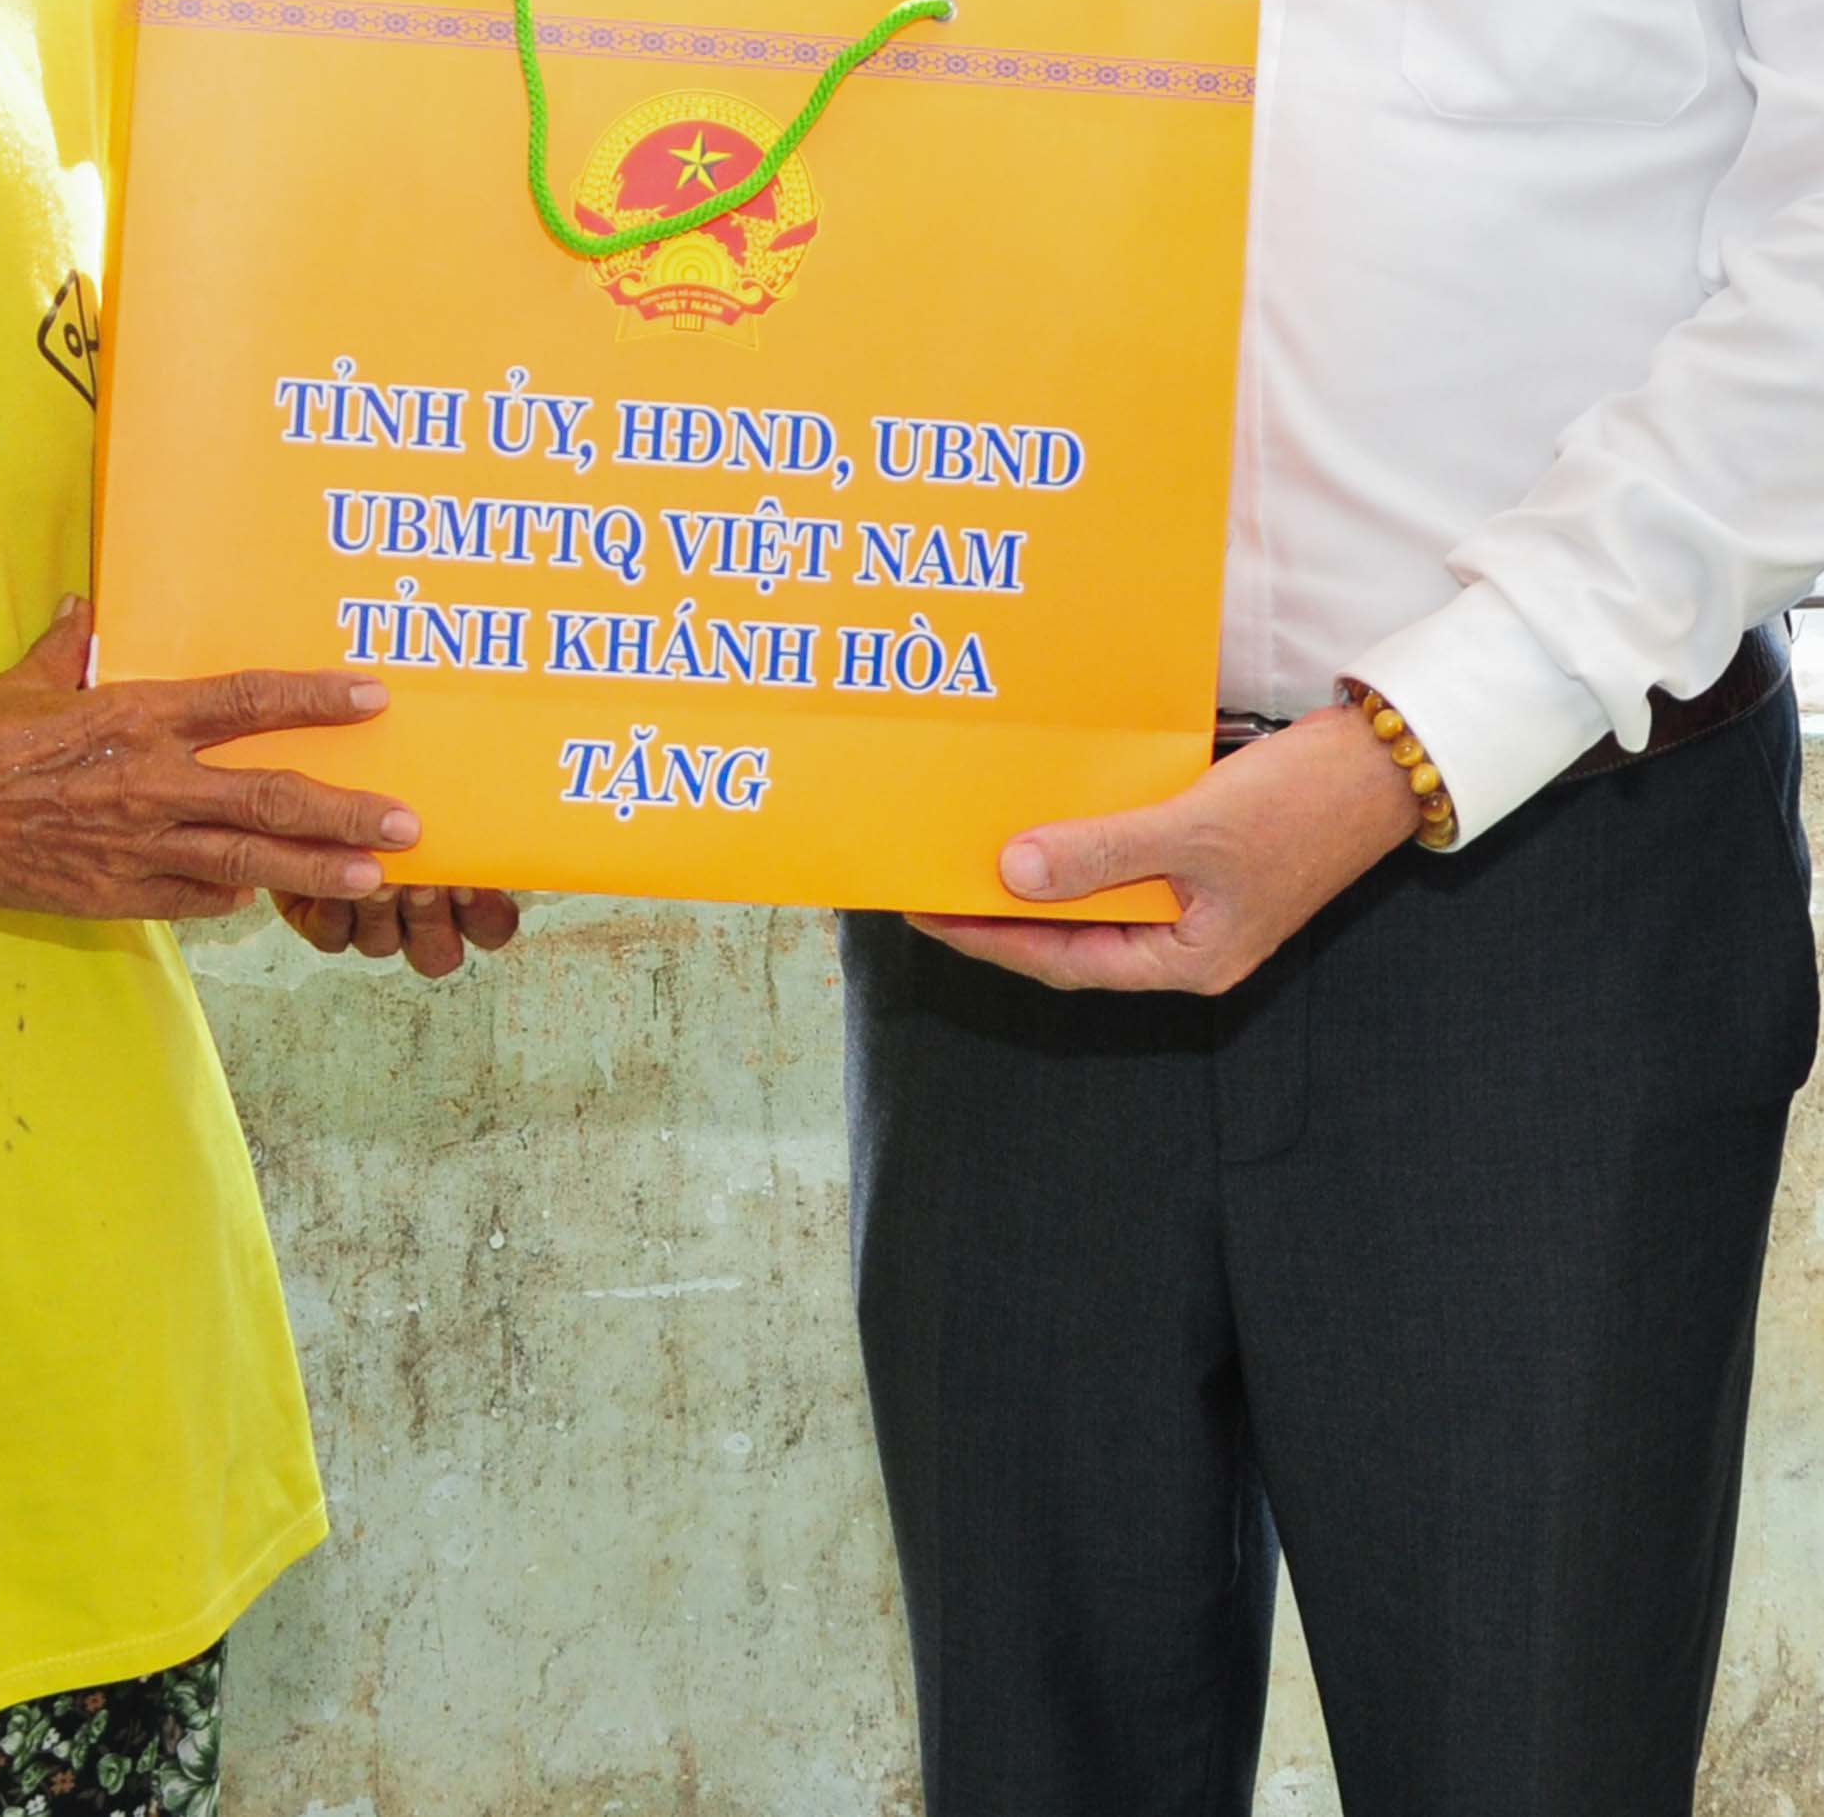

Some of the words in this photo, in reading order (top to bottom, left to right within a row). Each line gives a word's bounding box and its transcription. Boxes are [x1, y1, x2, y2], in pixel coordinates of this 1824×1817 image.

[276, 357, 467, 453] TỈNH
[486, 366, 597, 473] ỦY,
[614, 400, 855, 488] HĐND,
[872, 416, 1086, 490] UBND
[325, 489, 647, 585] UBMTTQ
[662, 496, 843, 595] VIỆT
[855, 522, 1026, 593] NAM
[339, 577, 530, 672] TỈNH
[547, 598, 820, 688] KHÁNH
[835, 613, 996, 697] HÒA
[561, 724, 770, 821] TẶNG
